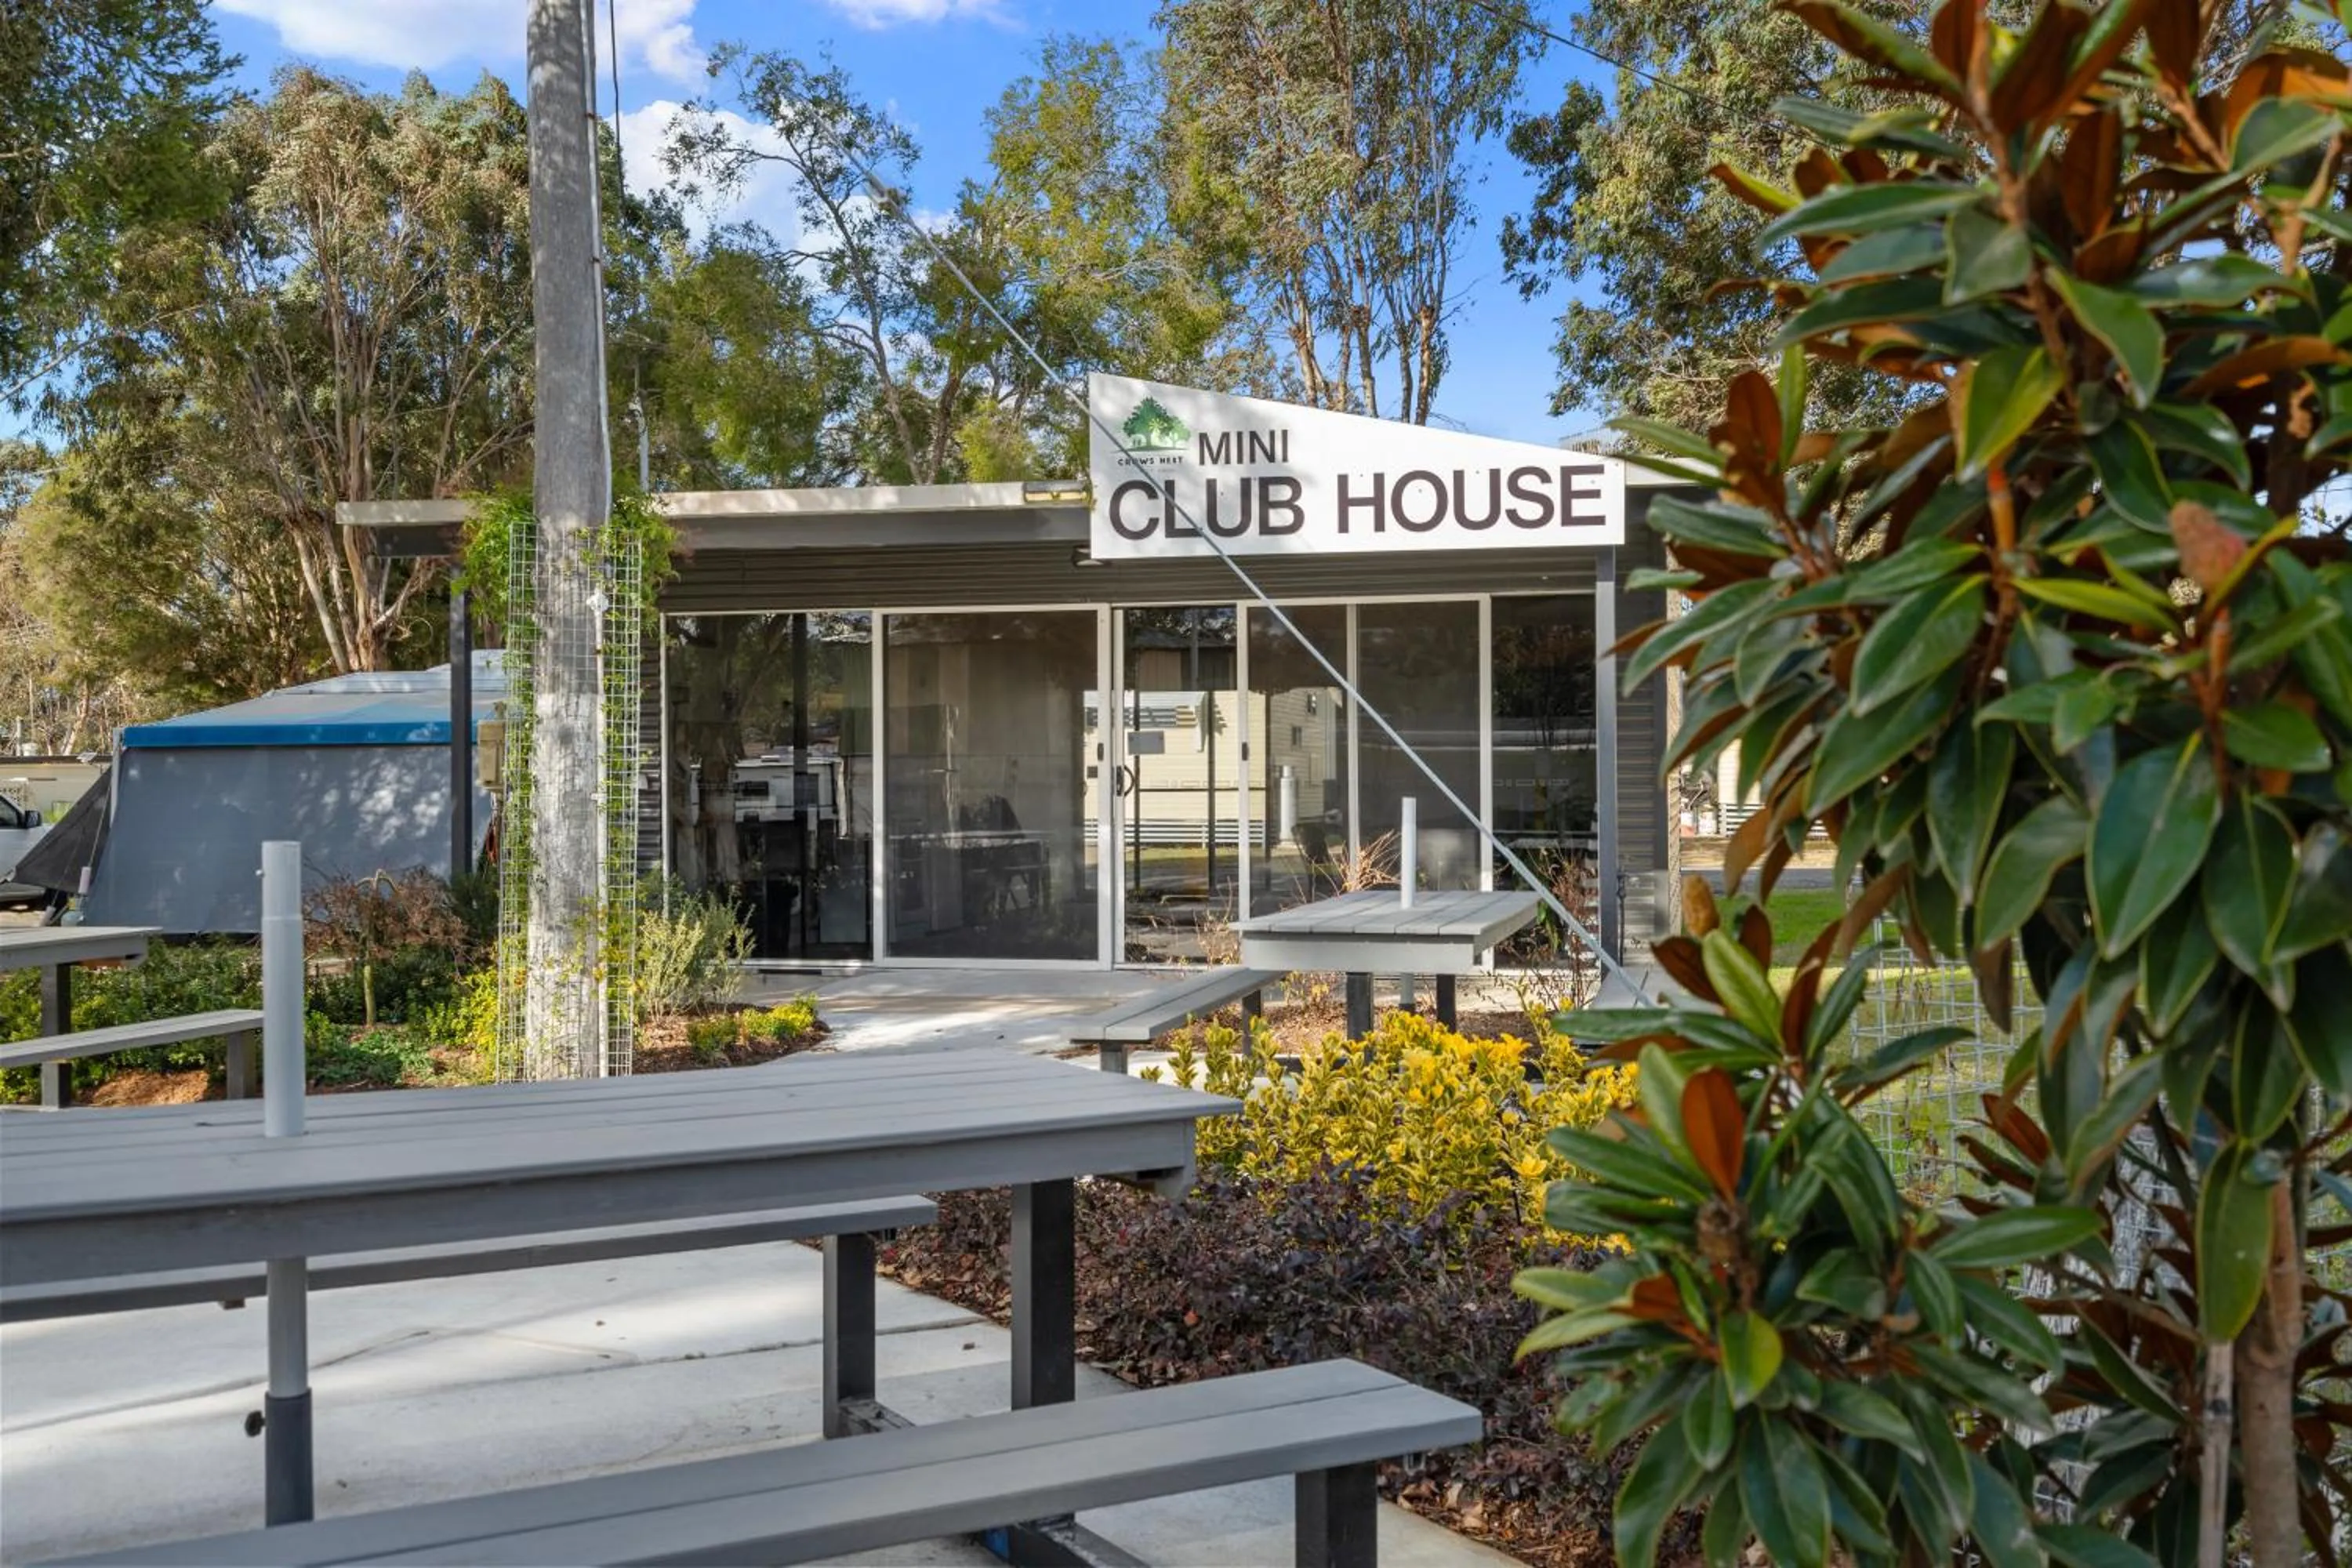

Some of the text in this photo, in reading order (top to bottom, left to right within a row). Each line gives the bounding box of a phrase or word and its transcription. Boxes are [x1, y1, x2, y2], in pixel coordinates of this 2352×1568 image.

[1199, 429, 1289, 466] MINI
[1109, 464, 1606, 540] CLUB HOUSE
